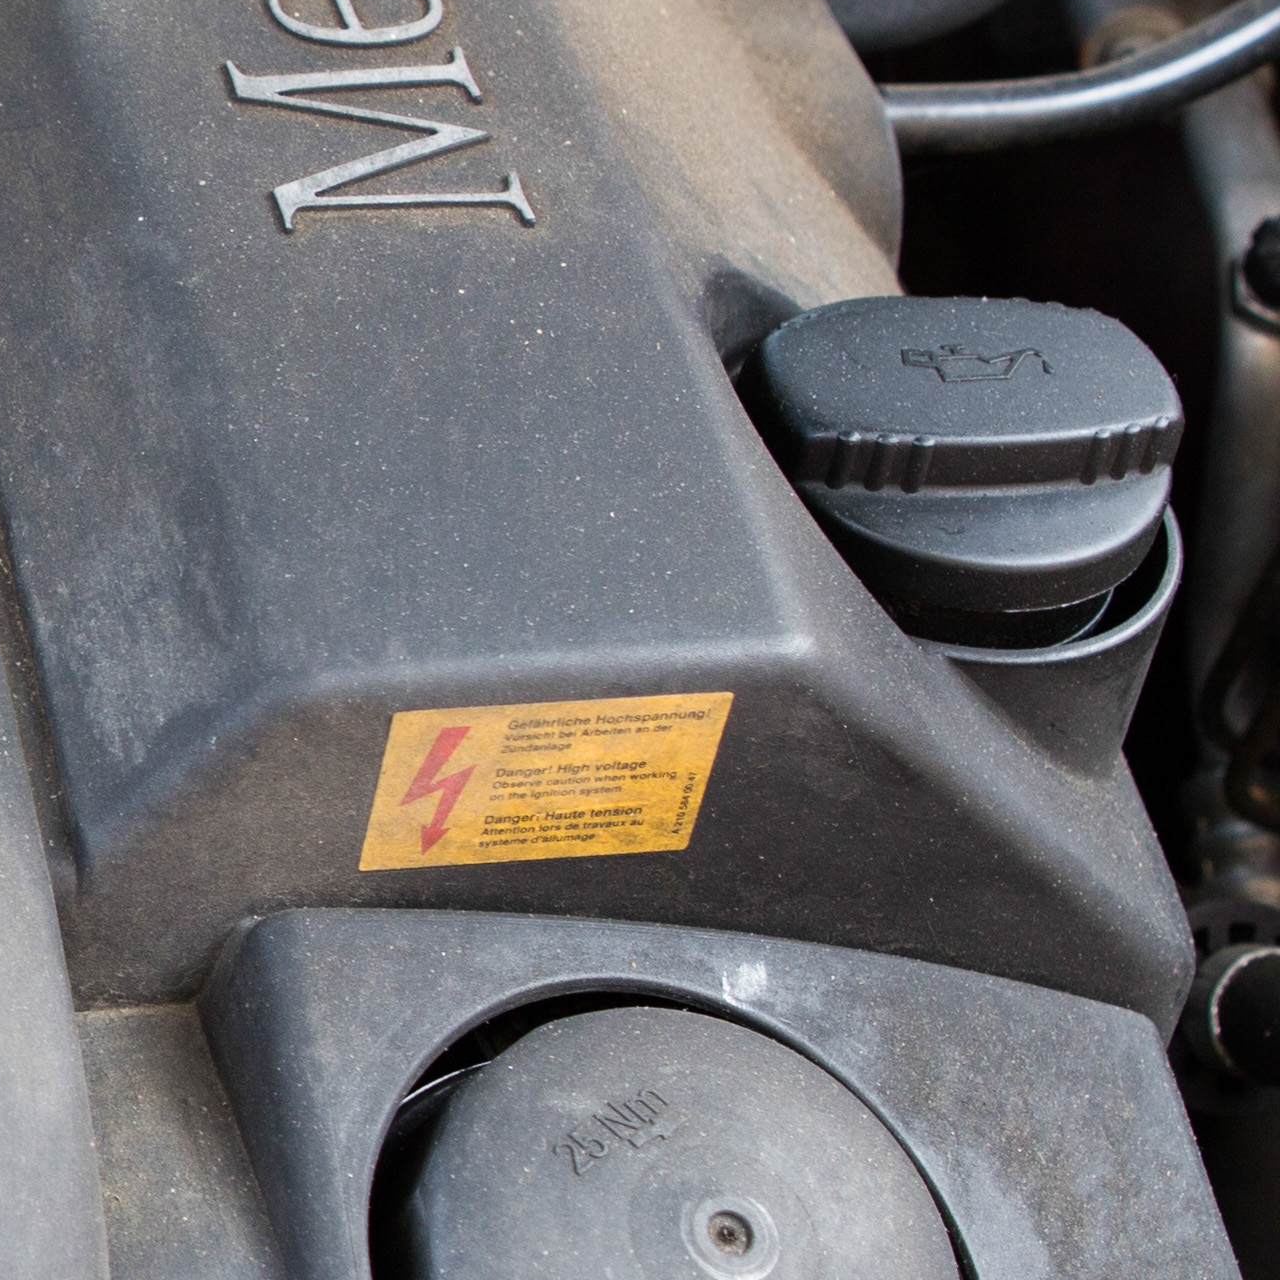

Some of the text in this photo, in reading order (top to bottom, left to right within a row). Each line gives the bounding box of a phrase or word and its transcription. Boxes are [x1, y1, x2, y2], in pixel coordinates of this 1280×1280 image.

[595, 708, 712, 725] Hochspannung!
[558, 729, 578, 739] bei
[581, 726, 632, 738] Arbeiten
[634, 725, 650, 733] an
[653, 724, 673, 733] der
[495, 759, 647, 779] Danger! High voltage
[492, 770, 677, 790] Observe caution when working
[489, 785, 622, 801] on the ignition system
[545, 809, 586, 822] Haute
[590, 805, 643, 818] tension
[480, 825, 536, 837] Attention
[564, 821, 580, 830] de
[582, 818, 627, 829] travaux
[629, 818, 645, 827] au
[531, 832, 596, 845] d'allumage
[551, 1088, 669, 1177] 25 Nm
